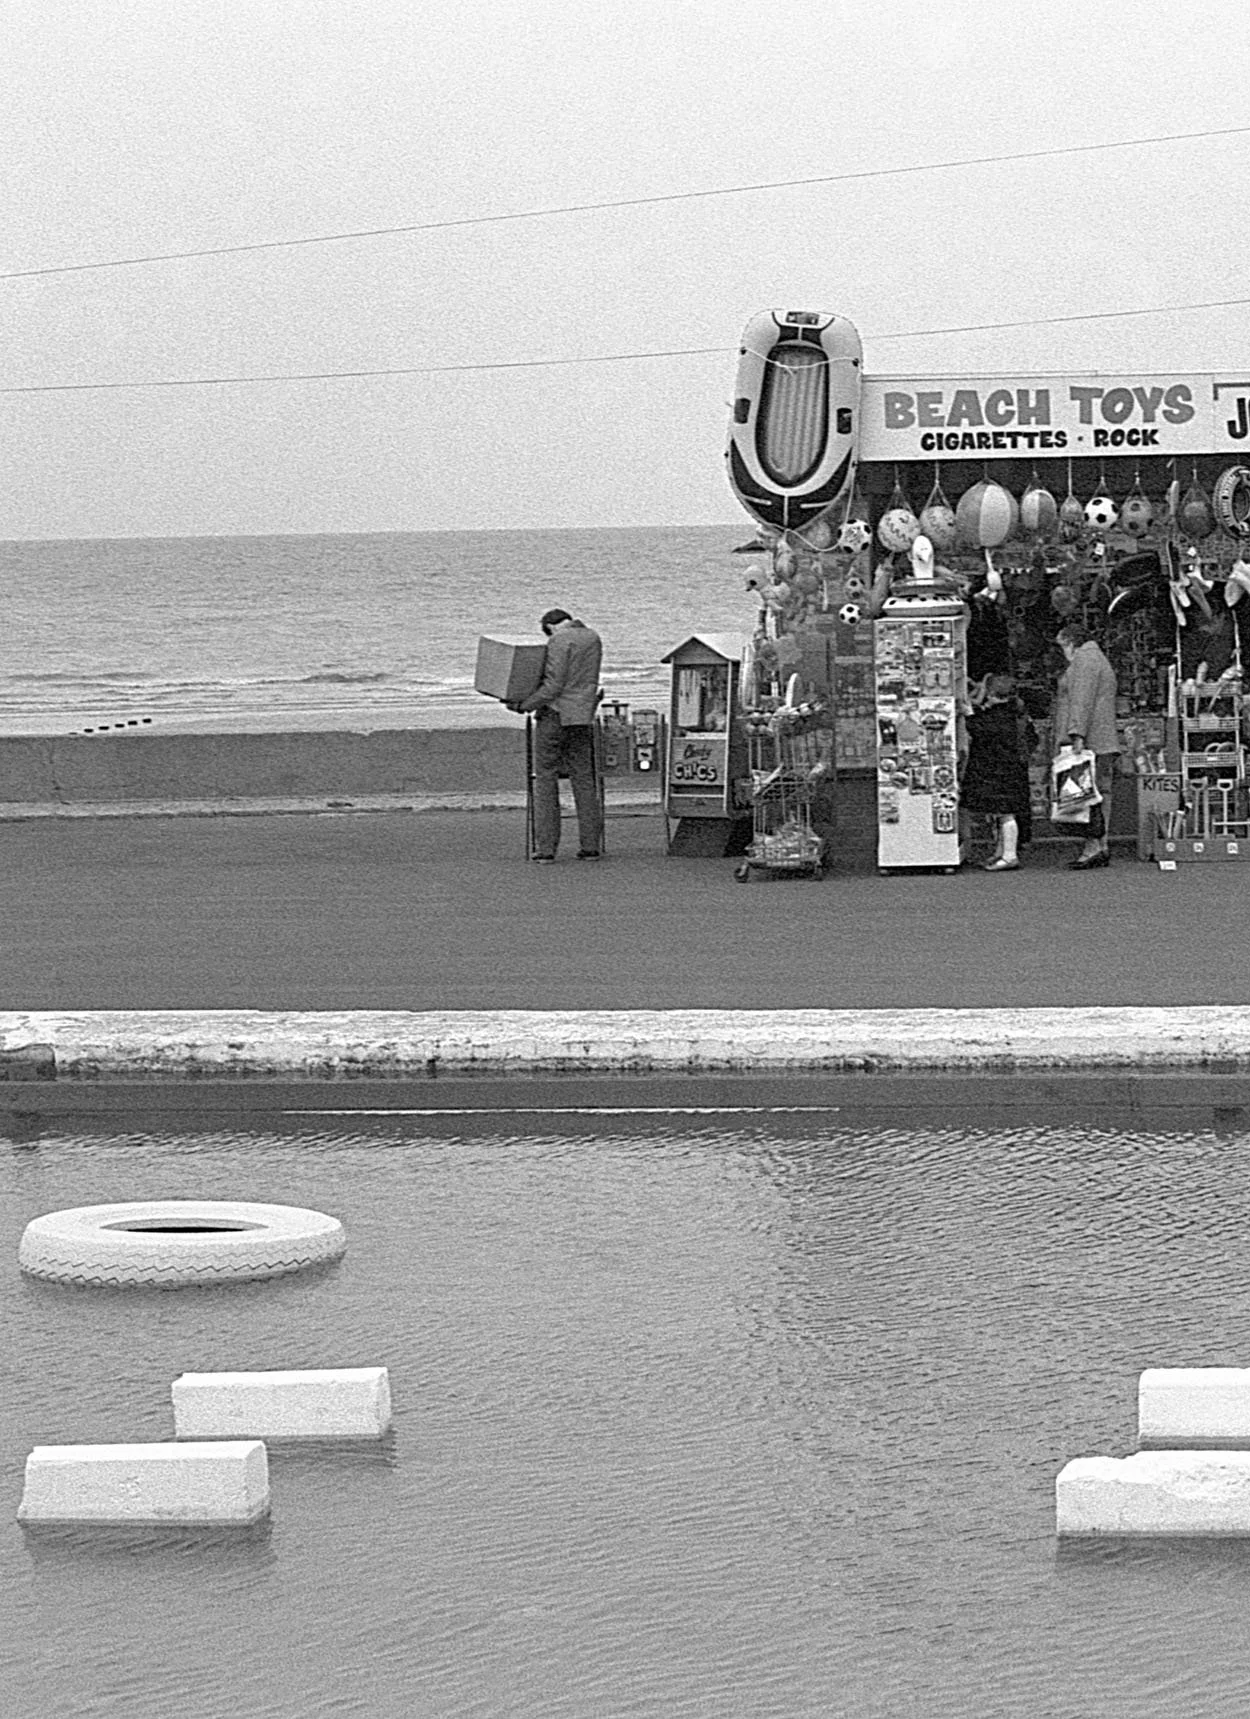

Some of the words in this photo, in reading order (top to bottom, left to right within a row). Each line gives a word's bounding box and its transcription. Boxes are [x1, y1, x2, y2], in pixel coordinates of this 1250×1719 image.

[884, 388, 1051, 429] BEACH
[1069, 384, 1196, 425] TOYS
[920, 430, 1067, 451] CIGARETTES
[1093, 428, 1160, 447] ROCK
[1142, 777, 1179, 792] KITES
